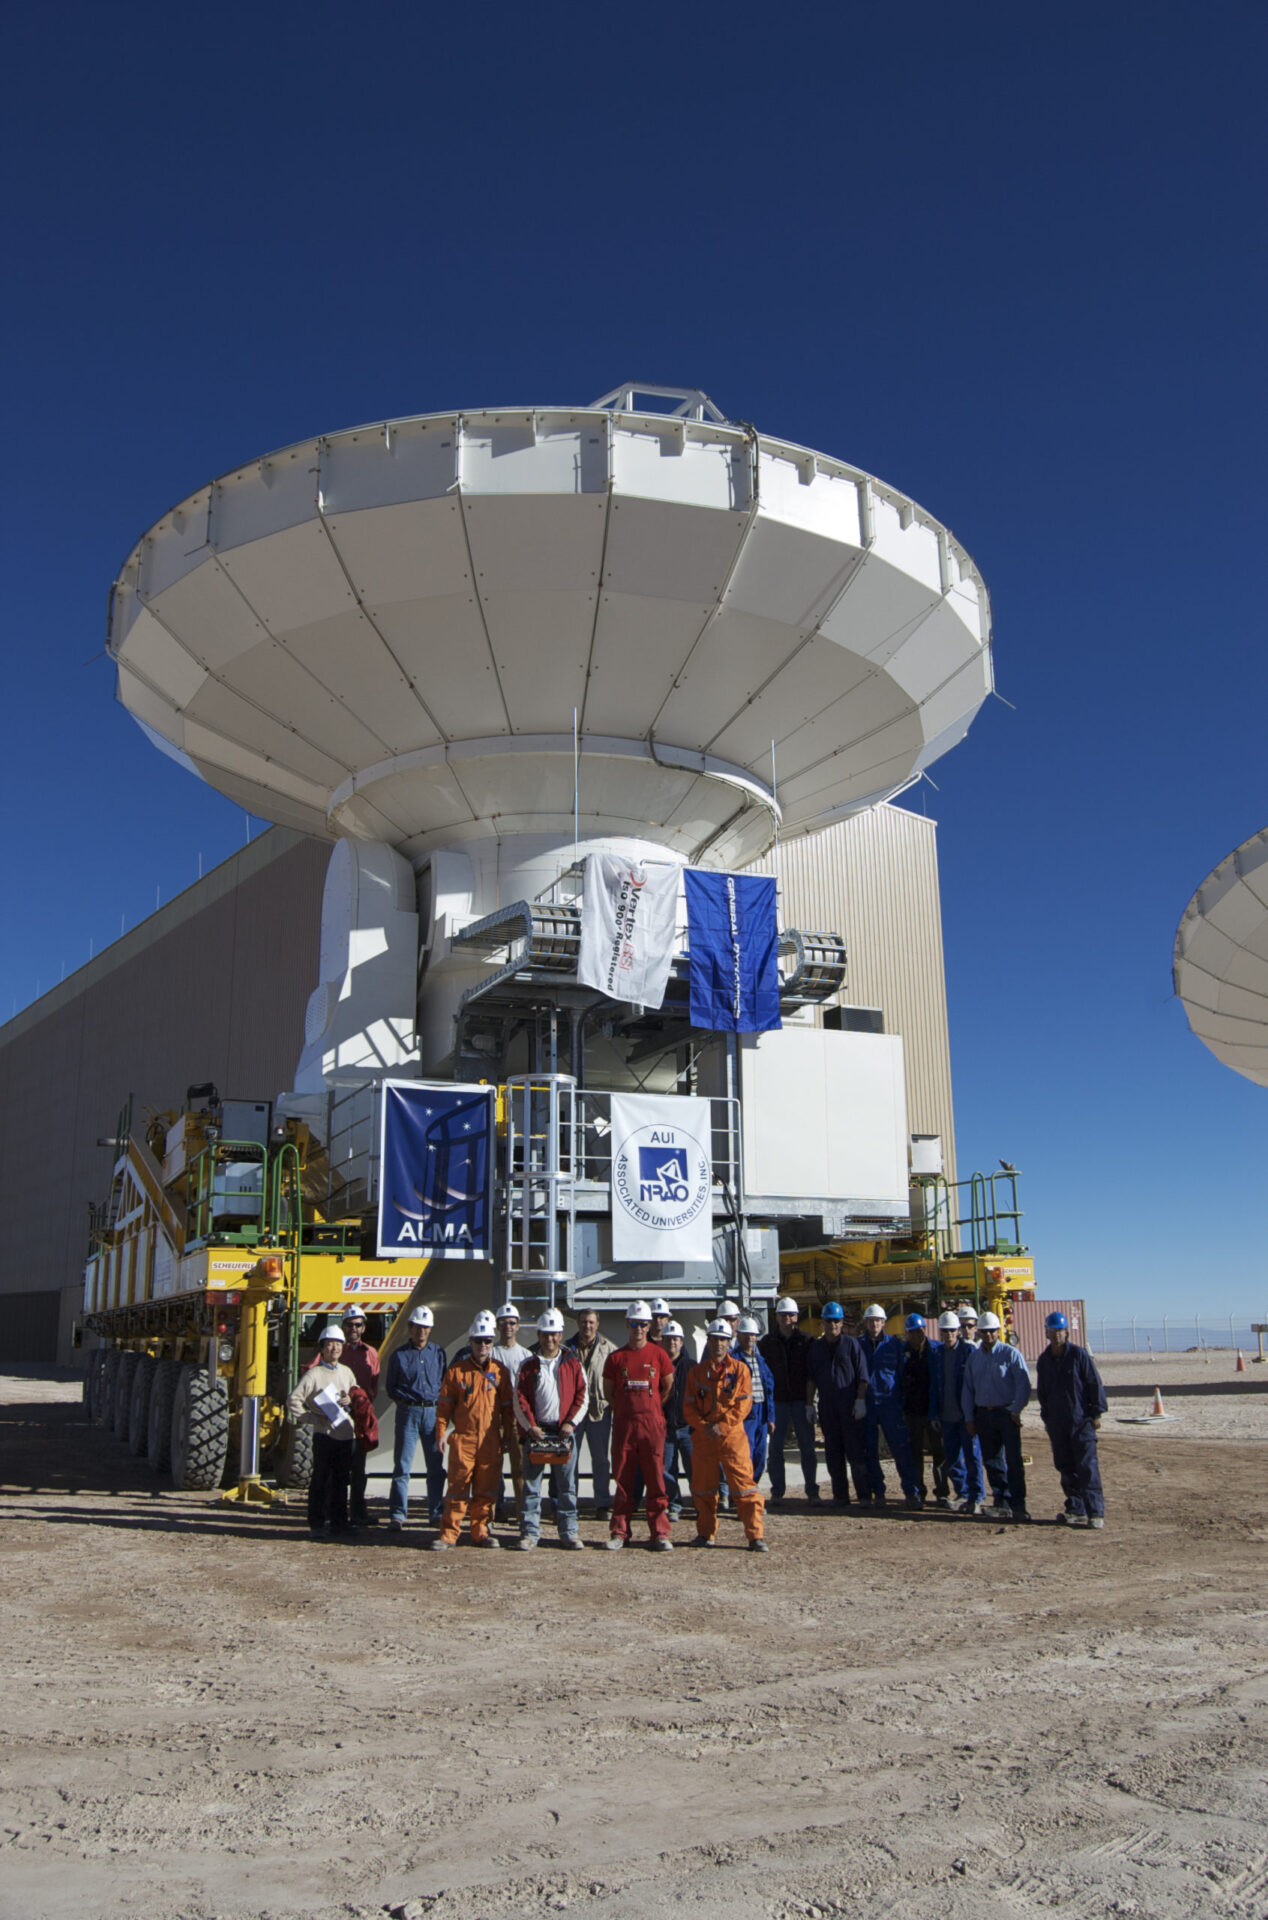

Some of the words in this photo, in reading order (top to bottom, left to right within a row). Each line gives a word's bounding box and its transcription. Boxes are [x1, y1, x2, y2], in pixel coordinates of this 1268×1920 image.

[727, 877, 739, 936] GENERAL
[606, 931, 624, 992] Registered
[650, 1131, 675, 1144] AUI
[616, 1154, 650, 1222] ASSOCIATED
[640, 1184, 690, 1202] NRAO
[396, 1221, 474, 1243] ALMA
[361, 1277, 420, 1287] SCHEUE
